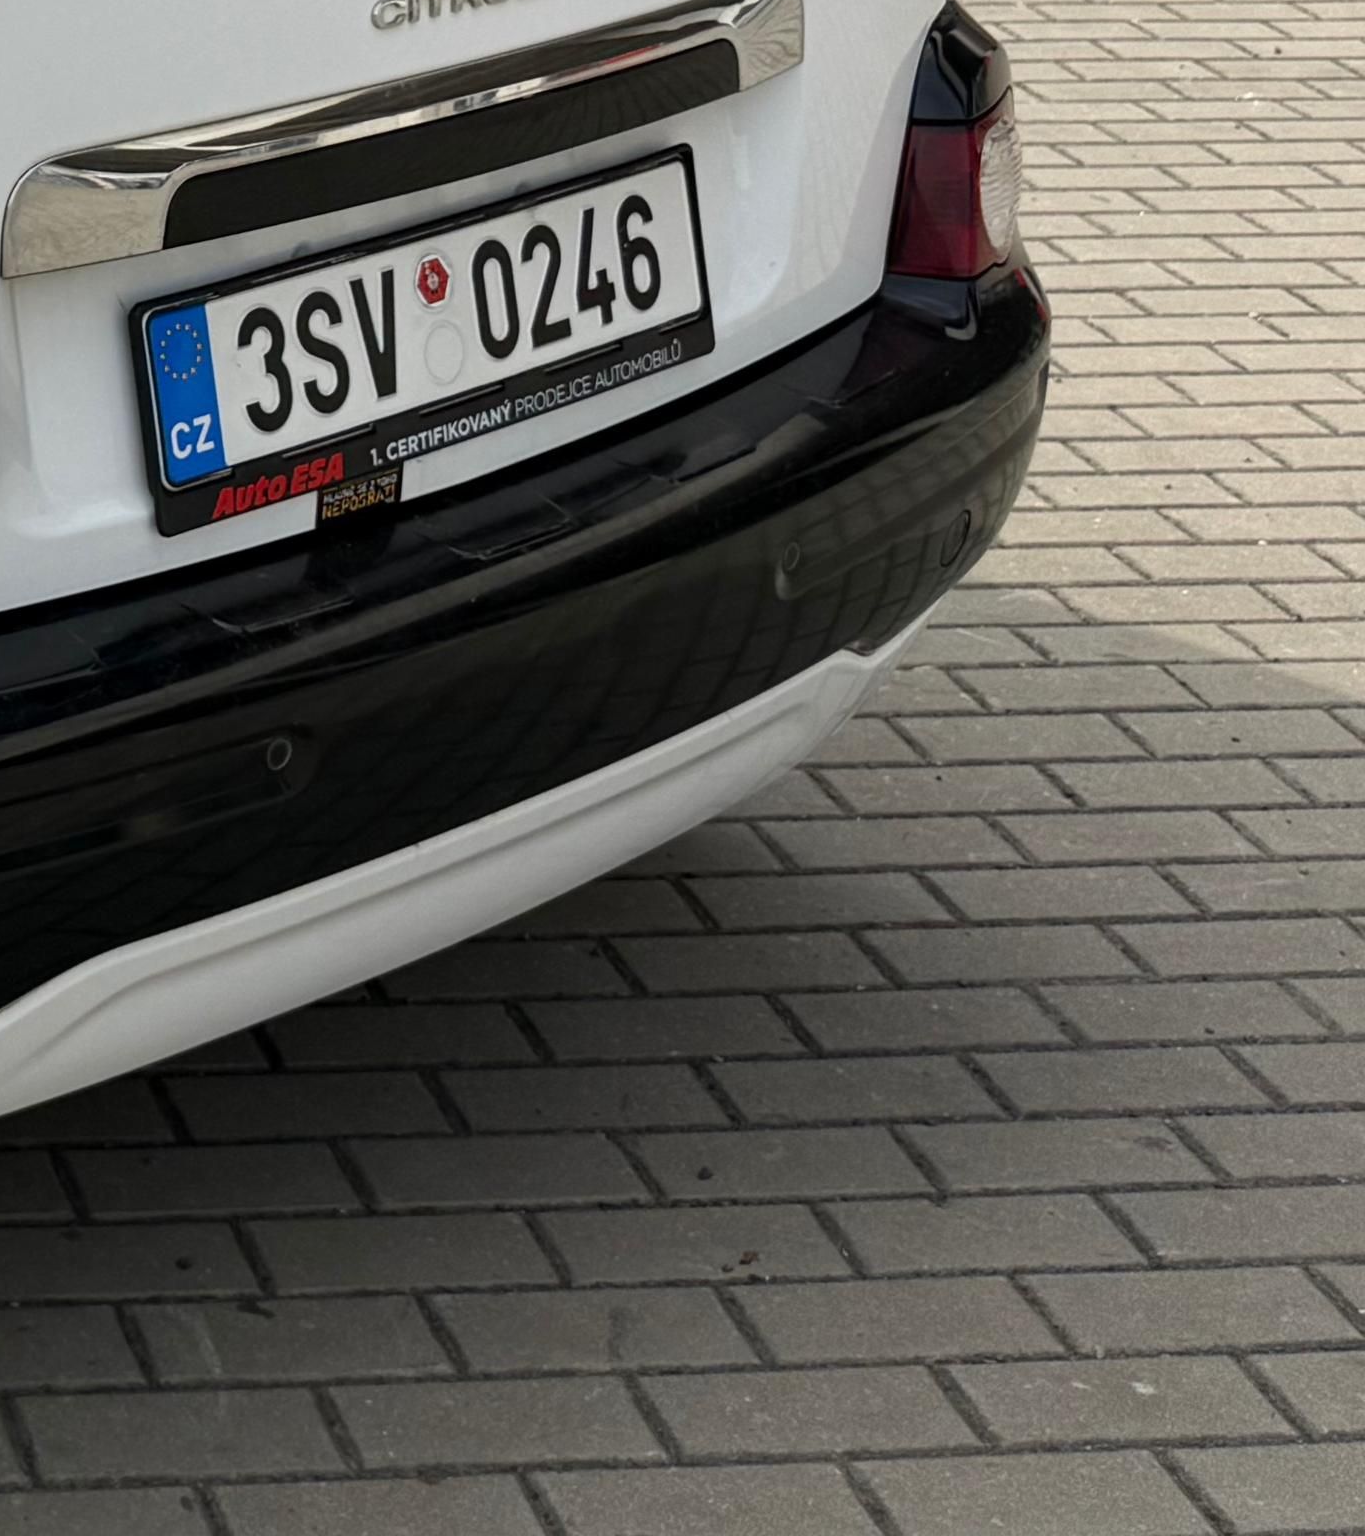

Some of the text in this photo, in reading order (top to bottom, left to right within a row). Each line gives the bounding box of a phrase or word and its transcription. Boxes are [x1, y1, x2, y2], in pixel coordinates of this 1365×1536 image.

[237, 194, 662, 433] 3SV 0246
[171, 413, 215, 460] CZ
[370, 338, 682, 466] 1. CERTIFIKOVANÝ PRODEJCE AUTOMOBILŮ
[212, 452, 345, 520] Auto ESA
